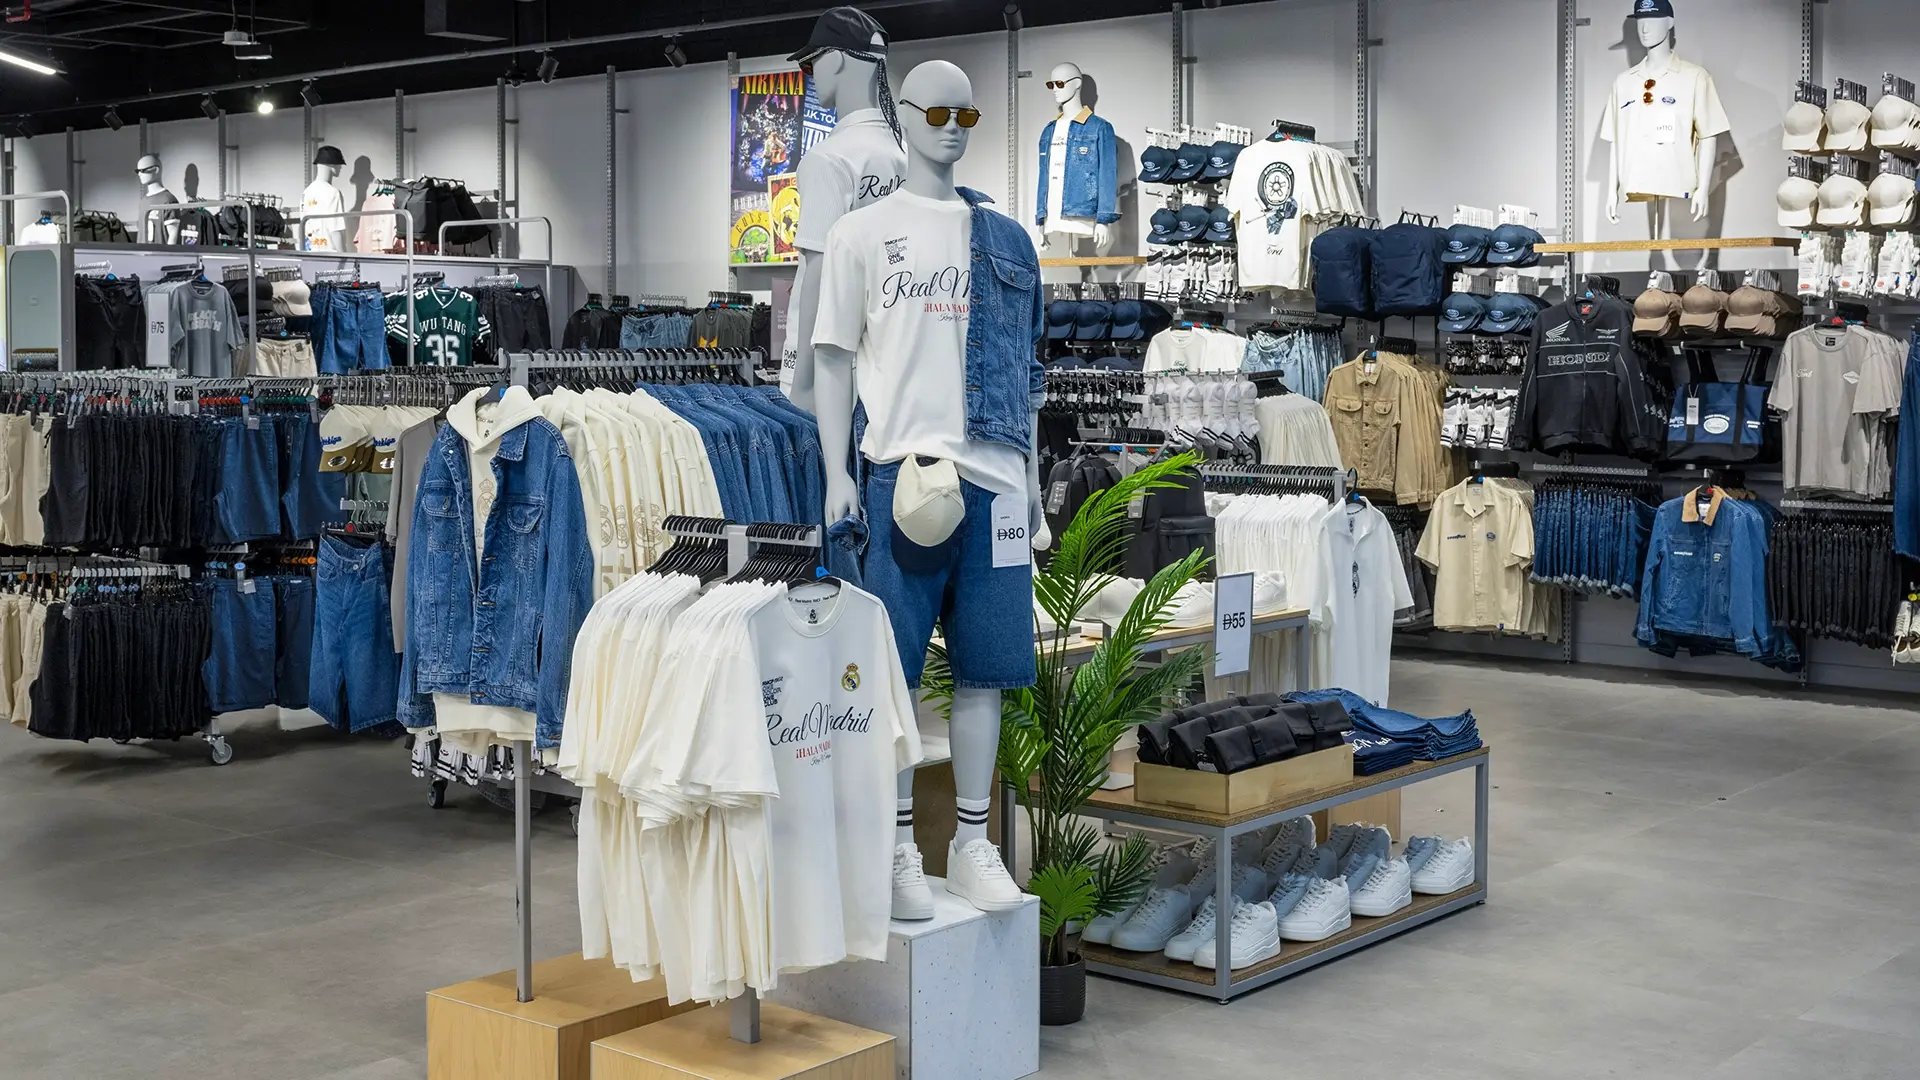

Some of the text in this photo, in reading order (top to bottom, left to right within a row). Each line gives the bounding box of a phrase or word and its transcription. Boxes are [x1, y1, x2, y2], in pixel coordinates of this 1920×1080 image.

[741, 71, 804, 96] NIRVANA
[859, 175, 894, 199] Real
[888, 256, 905, 265] CLUB
[882, 270, 940, 309] Real
[420, 316, 467, 336] WU TANG
[425, 334, 460, 367] 36
[766, 701, 874, 746] Real Madrid
